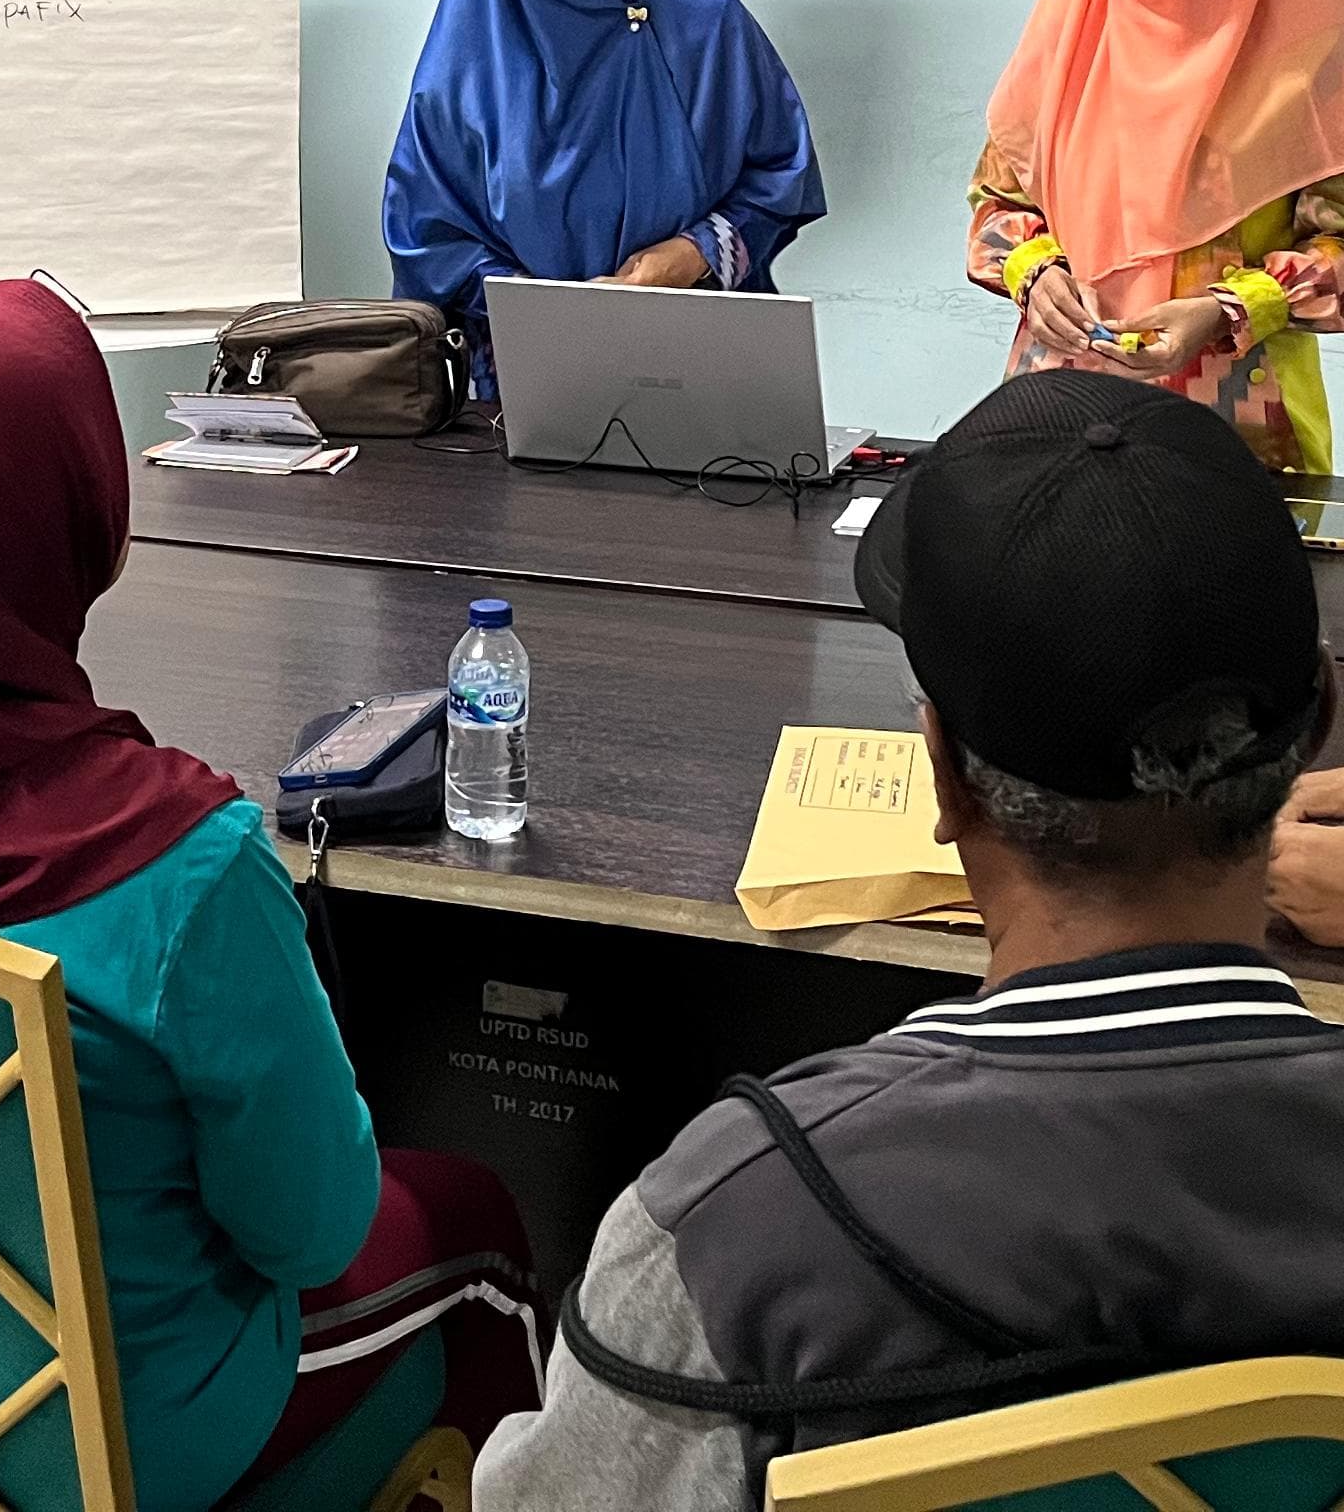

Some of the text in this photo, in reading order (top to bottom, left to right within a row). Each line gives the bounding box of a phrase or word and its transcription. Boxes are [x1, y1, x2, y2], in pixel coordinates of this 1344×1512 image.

[482, 690, 518, 707] AQUA
[479, 1017, 590, 1049] UPTD RSUD
[448, 1051, 621, 1092] KOTA PONTIANAK
[490, 1094, 576, 1123] TH. 2017
